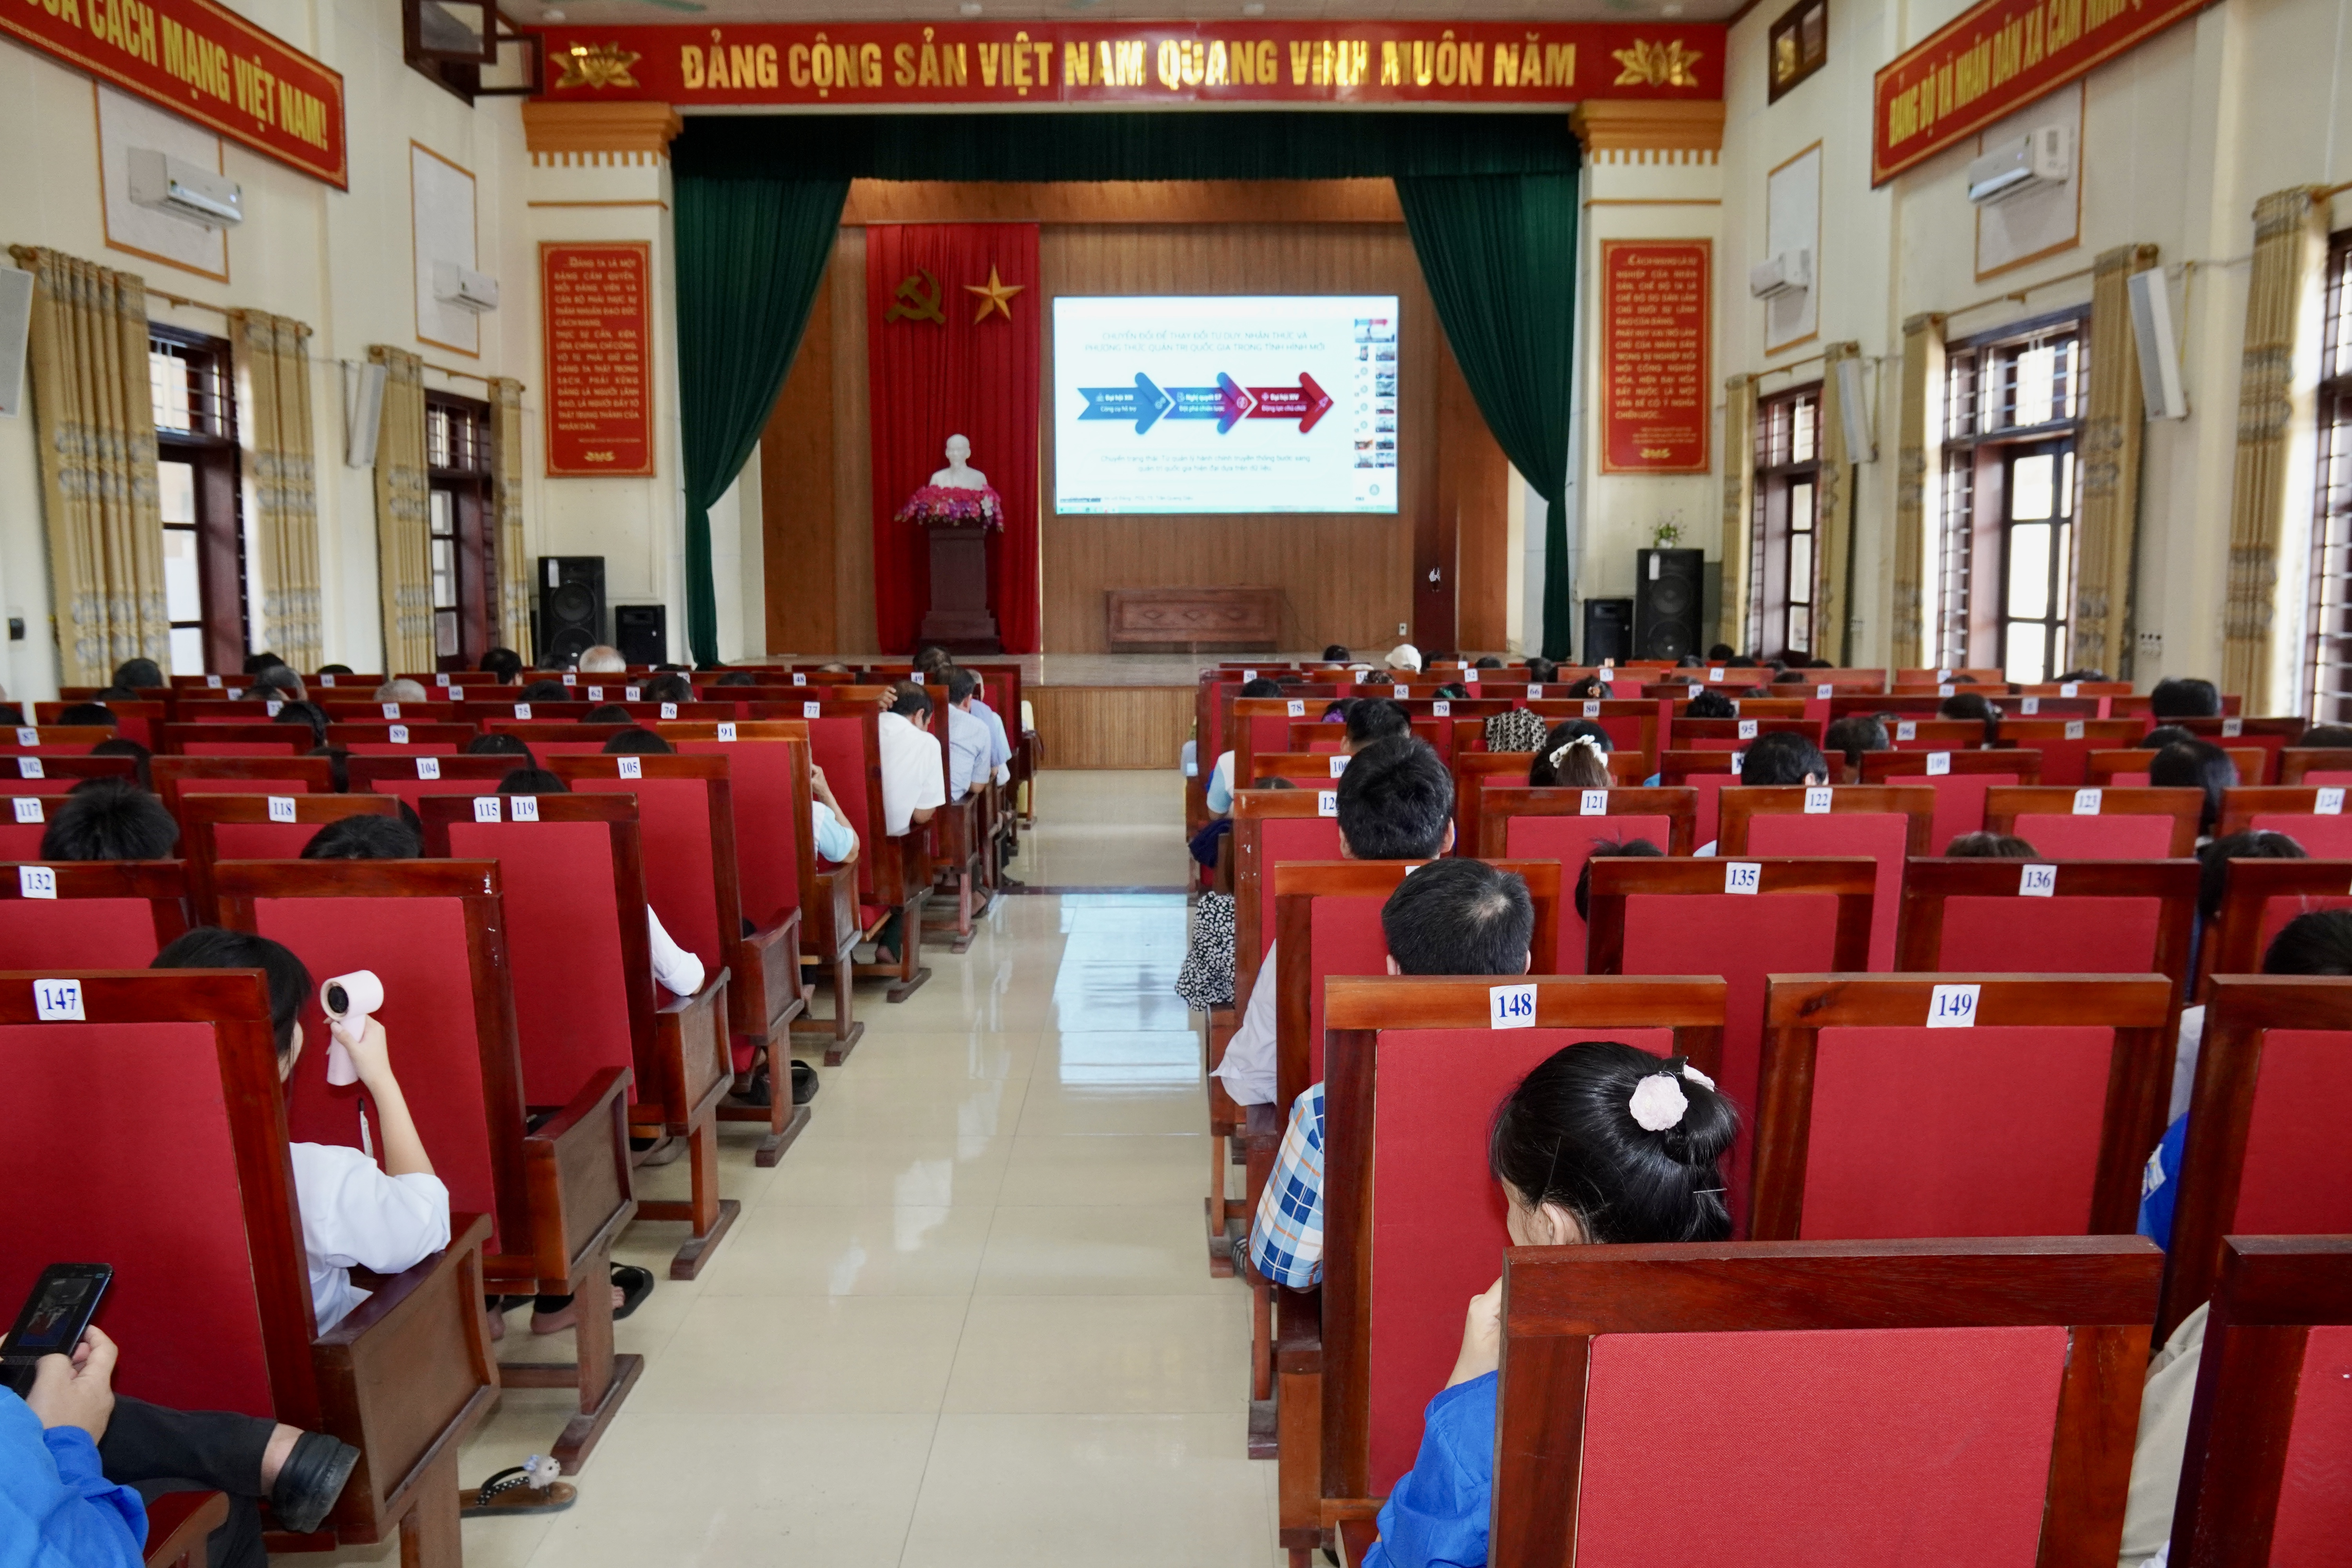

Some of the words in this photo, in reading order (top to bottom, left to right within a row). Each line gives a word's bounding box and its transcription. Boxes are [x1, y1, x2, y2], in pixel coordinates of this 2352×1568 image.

[681, 28, 779, 89] ĐẢNG
[788, 32, 883, 97] CỘNG
[894, 26, 967, 87] SẢN
[978, 31, 1053, 96] VIỆT
[1065, 40, 1147, 87] NAM
[1157, 39, 1278, 91] QUANG
[1290, 40, 1368, 87] VINH
[1381, 29, 1484, 87] MUÔN
[1493, 31, 1577, 87] NĂM
[162, 15, 230, 103] MẠNG
[233, 54, 274, 132] VIỆT
[279, 80, 328, 151] NAM!
[664, 706, 675, 715] 76
[807, 706, 818, 714] 77
[392, 729, 406, 738] 89
[721, 728, 733, 737] 91
[1740, 724, 1755, 735] 95
[419, 762, 436, 774] 104
[622, 762, 638, 773] 105
[1323, 797, 1338, 810] 12
[1585, 796, 1603, 809] 121
[1809, 794, 1828, 807] 122
[2078, 795, 2097, 808] 123
[19, 803, 39, 817] 117
[273, 802, 292, 816] 118
[479, 803, 497, 816] 115
[516, 802, 534, 815] 119
[27, 873, 52, 890] 132
[1730, 869, 1756, 887] 135
[2026, 869, 2051, 888] 136
[43, 988, 77, 1010] 147
[1499, 993, 1532, 1018] 148
[1938, 994, 1972, 1016] 149
